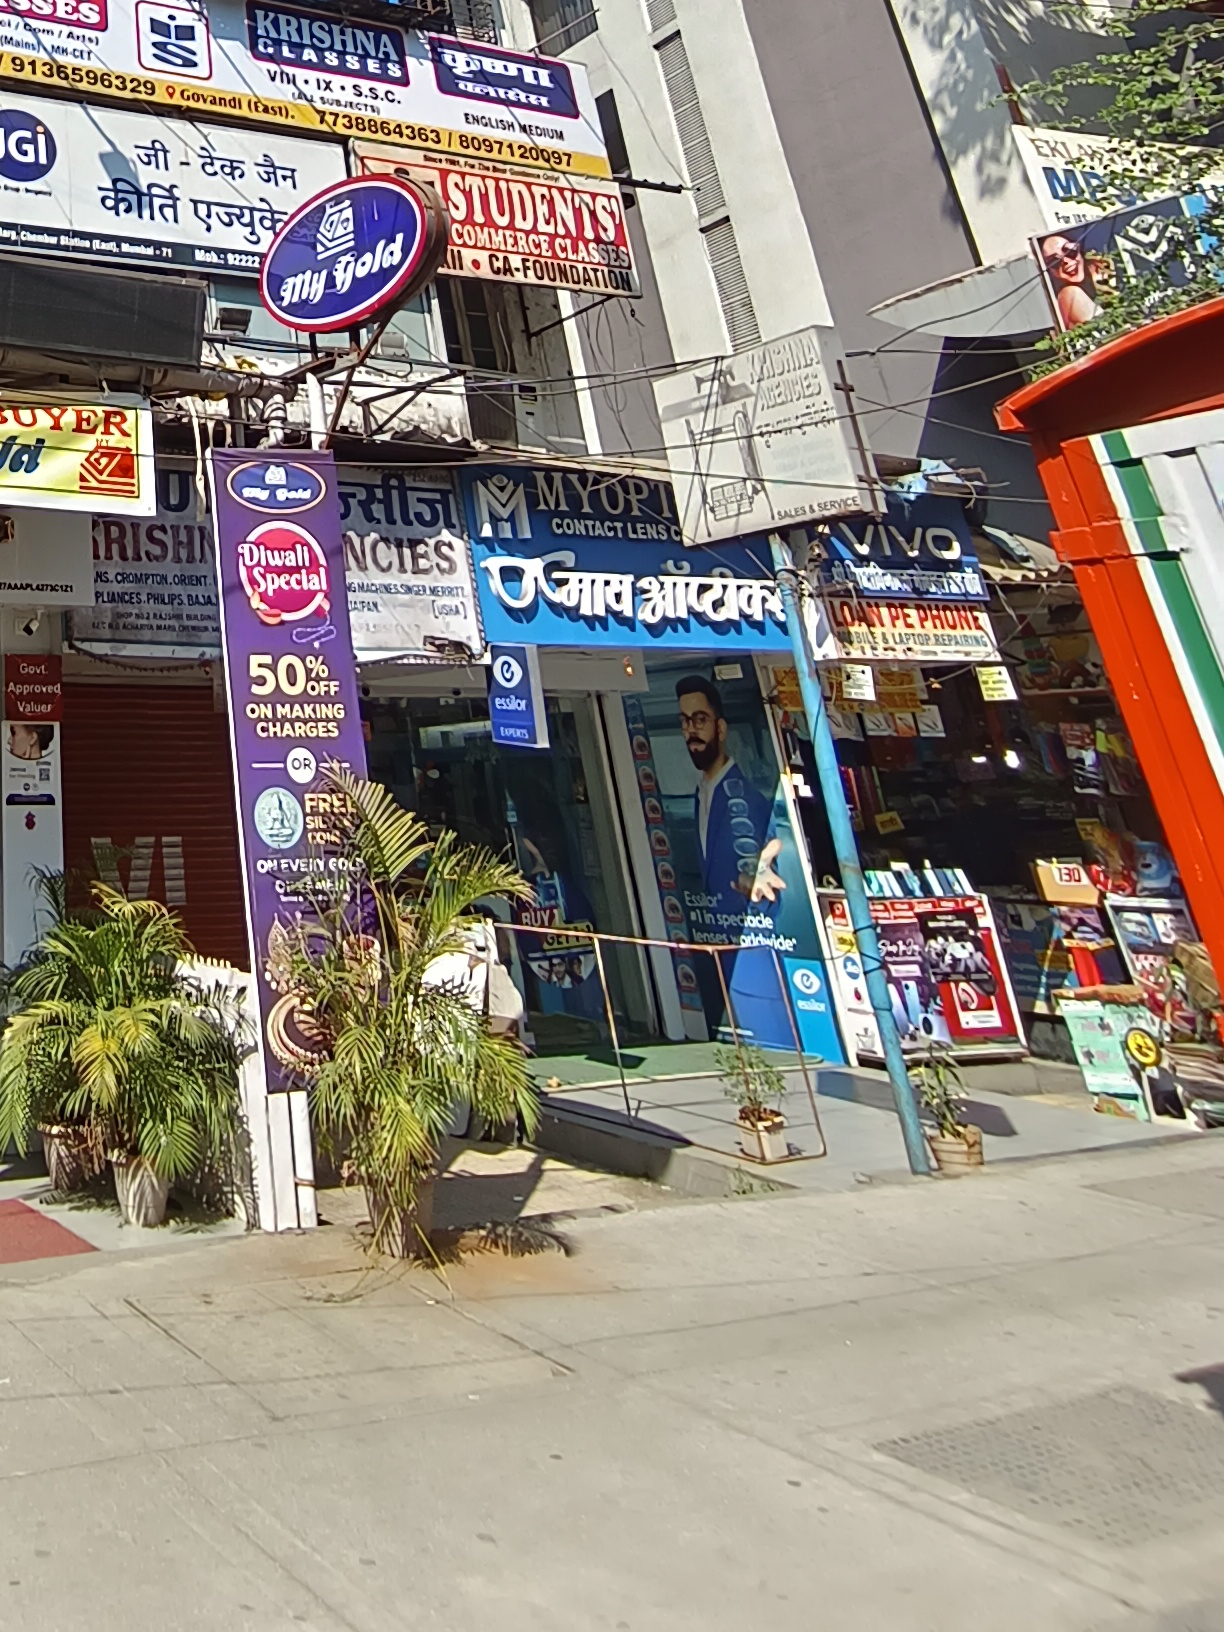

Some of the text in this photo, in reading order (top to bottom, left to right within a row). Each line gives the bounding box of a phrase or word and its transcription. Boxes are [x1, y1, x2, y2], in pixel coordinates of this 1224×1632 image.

[254, 9, 400, 61] KRISHNA
[257, 37, 403, 78] CLASSES
[10, 55, 156, 96] 9136596329
[316, 78, 333, 93] IX
[352, 85, 402, 105] S.S.C.
[180, 88, 242, 111] Govandi
[316, 109, 441, 145] 7738864363
[459, 135, 573, 168] 8097120097
[464, 112, 565, 142] ENGLISH MEDIUM
[134, 139, 298, 189] जी टेक जैन
[97, 177, 181, 224] कीर्ति
[450, 223, 629, 269] COMMERCE CLASSES
[280, 233, 404, 307] My Gold
[489, 254, 632, 292] CA-FOUNDATION
[531, 470, 674, 519] MYOPT
[776, 506, 806, 521] SALES
[817, 495, 861, 513] SERVICE
[552, 517, 624, 539] CONTACT
[628, 522, 668, 541] LENS
[837, 521, 962, 560] VIVO
[237, 543, 310, 567] Diwali
[252, 566, 328, 597] Special
[829, 600, 983, 631] LOAN PE PHONE
[892, 632, 931, 646] LAPTOP
[934, 634, 988, 648] REPAIRING
[19, 663, 49, 676] Govt.
[7, 681, 61, 696] Approved
[306, 680, 340, 696] OFF
[16, 700, 53, 713] Valuer
[246, 702, 346, 720] ON MAKING
[494, 694, 527, 711] essilor
[256, 721, 339, 739] CHARGES
[499, 726, 529, 739] EXPERTS
[290, 757, 313, 771] OR
[1056, 867, 1082, 883] 130
[521, 908, 550, 927] BUY
[717, 913, 774, 930] spectacle
[692, 928, 732, 945] lenses
